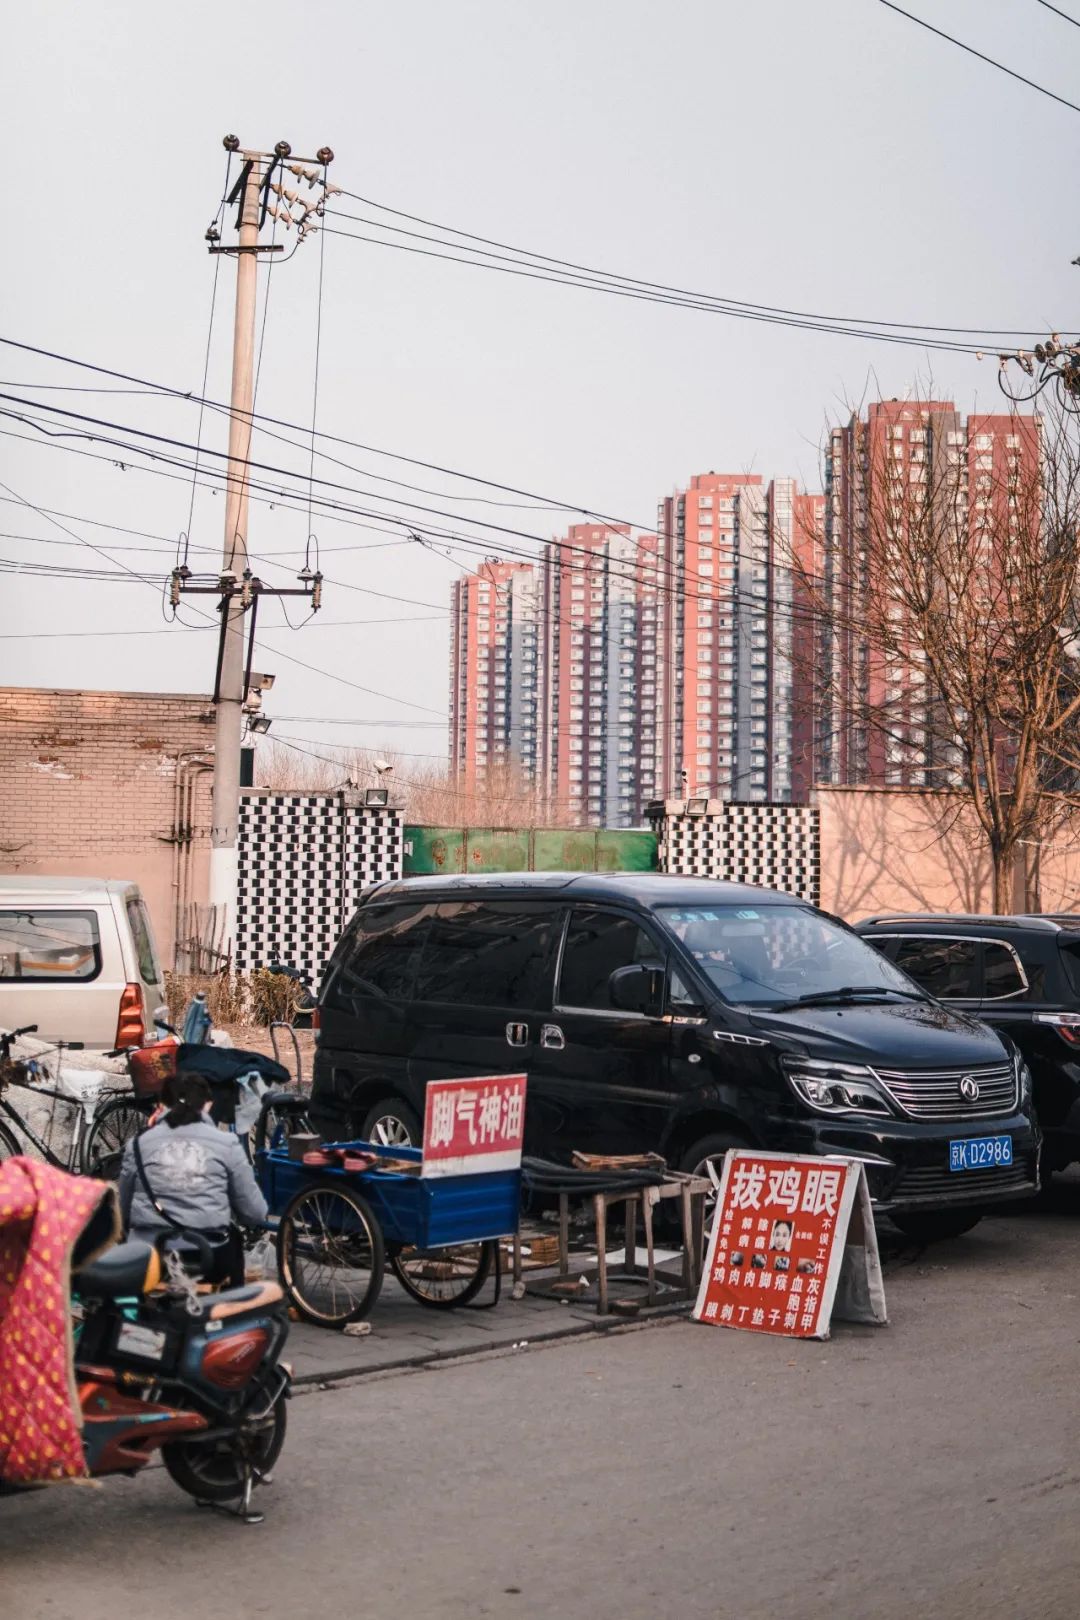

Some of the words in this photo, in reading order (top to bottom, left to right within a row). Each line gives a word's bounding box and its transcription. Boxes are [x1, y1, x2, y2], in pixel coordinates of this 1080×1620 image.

[429, 1084, 523, 1148] 脚气神油
[730, 1162, 841, 1217] 拔鸡眼
